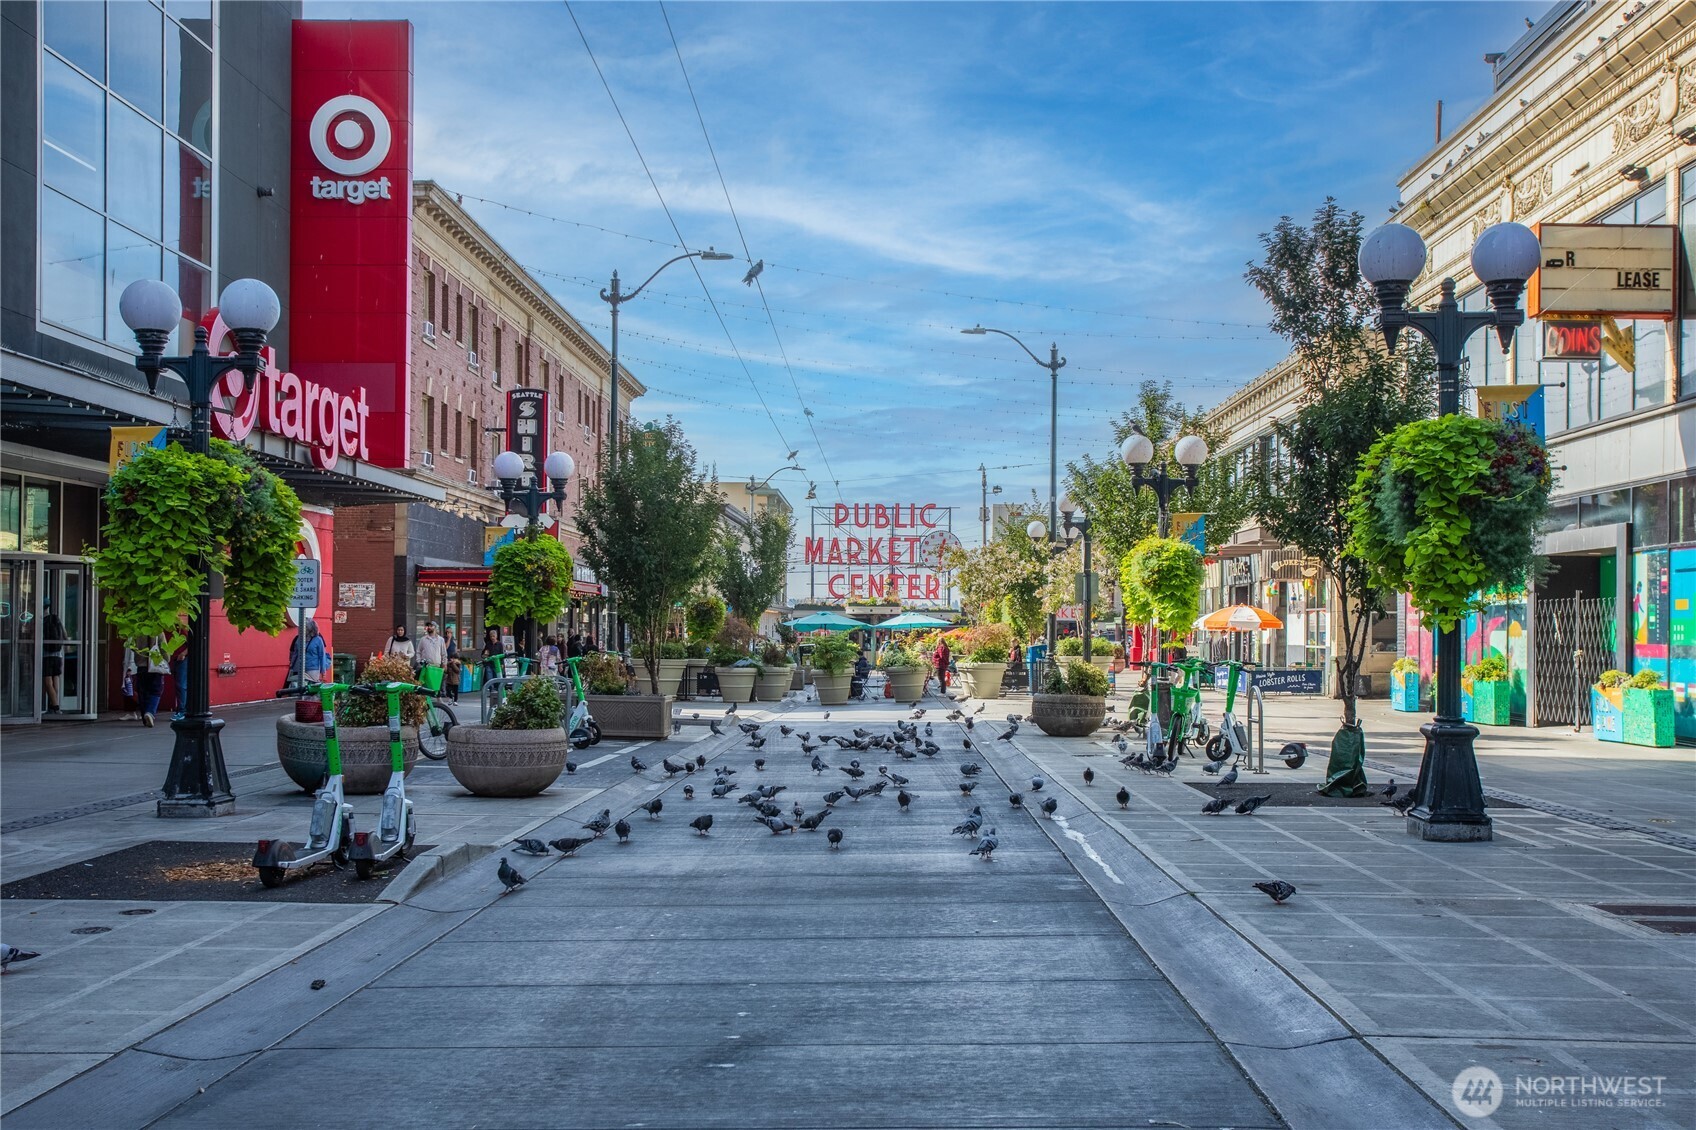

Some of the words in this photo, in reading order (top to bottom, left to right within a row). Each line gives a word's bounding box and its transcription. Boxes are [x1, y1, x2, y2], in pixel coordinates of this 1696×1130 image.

[310, 176, 392, 205] target
[1617, 271, 1660, 288] LEASE
[1547, 325, 1601, 355] COINS
[263, 345, 370, 471] target
[511, 391, 544, 400] SEATTLE
[1484, 400, 1529, 419] FIRST
[834, 502, 937, 529] PUBLIC
[804, 536, 922, 566] MARKET
[1279, 559, 1305, 567] LUKE'S
[828, 573, 940, 600] CENTER
[1259, 677, 1286, 687] LOBSTER
[1286, 673, 1306, 683] ROLLS
